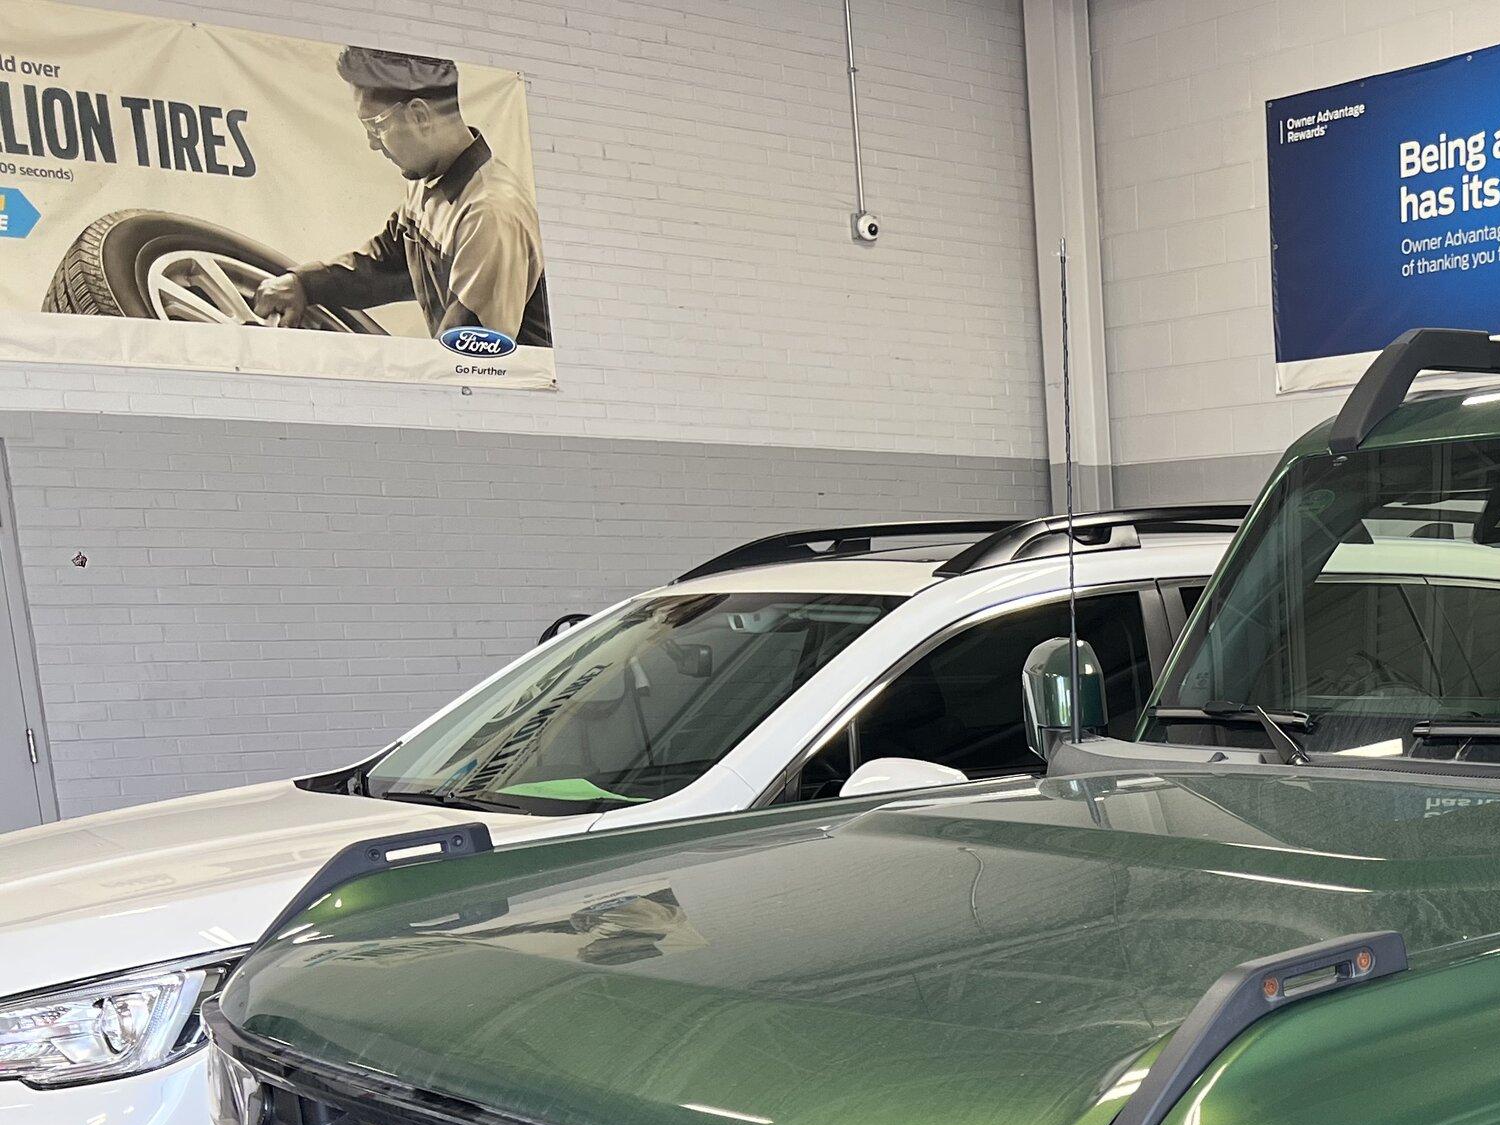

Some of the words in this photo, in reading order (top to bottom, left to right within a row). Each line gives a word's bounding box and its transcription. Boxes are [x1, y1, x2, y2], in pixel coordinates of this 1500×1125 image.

[20, 61, 61, 78] over
[0, 81, 118, 164] LION
[120, 96, 256, 178] TIRES
[1286, 115, 1316, 130] Owner
[1316, 103, 1365, 124] Advantage
[1399, 131, 1486, 178] Being
[20, 165, 74, 182] seconds)
[1400, 185, 1455, 223] has
[1462, 174, 1500, 211] its
[1401, 235, 1442, 255] Owner
[1401, 259, 1415, 277] of
[1416, 250, 1469, 275] thanking
[1472, 250, 1495, 271] you
[455, 365, 470, 374] Go
[471, 366, 507, 376] Further
